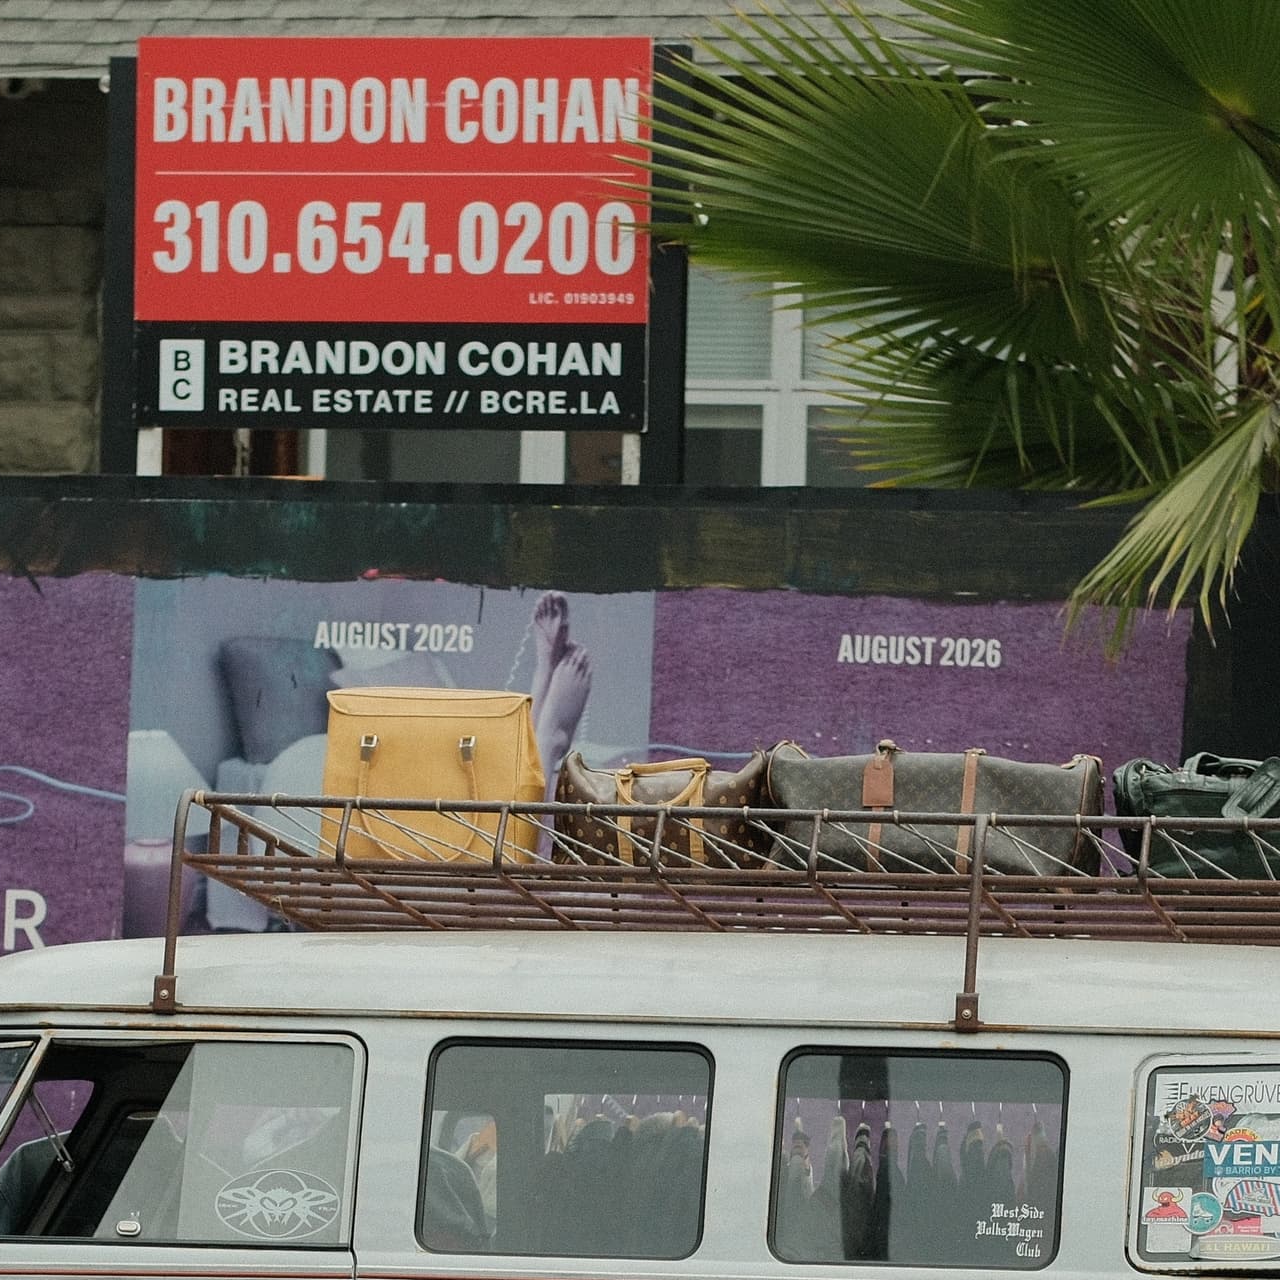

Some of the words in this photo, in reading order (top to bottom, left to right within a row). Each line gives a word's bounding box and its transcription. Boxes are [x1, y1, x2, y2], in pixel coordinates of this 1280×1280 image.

[153, 77, 427, 144] BRANDON
[444, 77, 639, 145] COHAN
[152, 199, 636, 276] 310.654.0200
[528, 292, 559, 305] LIC.
[174, 350, 191, 372] B
[219, 340, 446, 376] BRANDON
[457, 342, 621, 377] COHAN
[172, 379, 192, 401] C
[219, 389, 302, 413] REAL
[313, 389, 433, 414] ESTATE
[480, 390, 621, 415] BCRE.LA
[313, 621, 410, 651] AUGUST
[413, 623, 474, 652] 2026
[837, 634, 937, 665] AUGUST
[939, 637, 1002, 668] 2026
[1225, 1166, 1261, 1175] BARRIO
[1263, 1166, 1277, 1175] BY
[1016, 1241, 1040, 1257] Club
